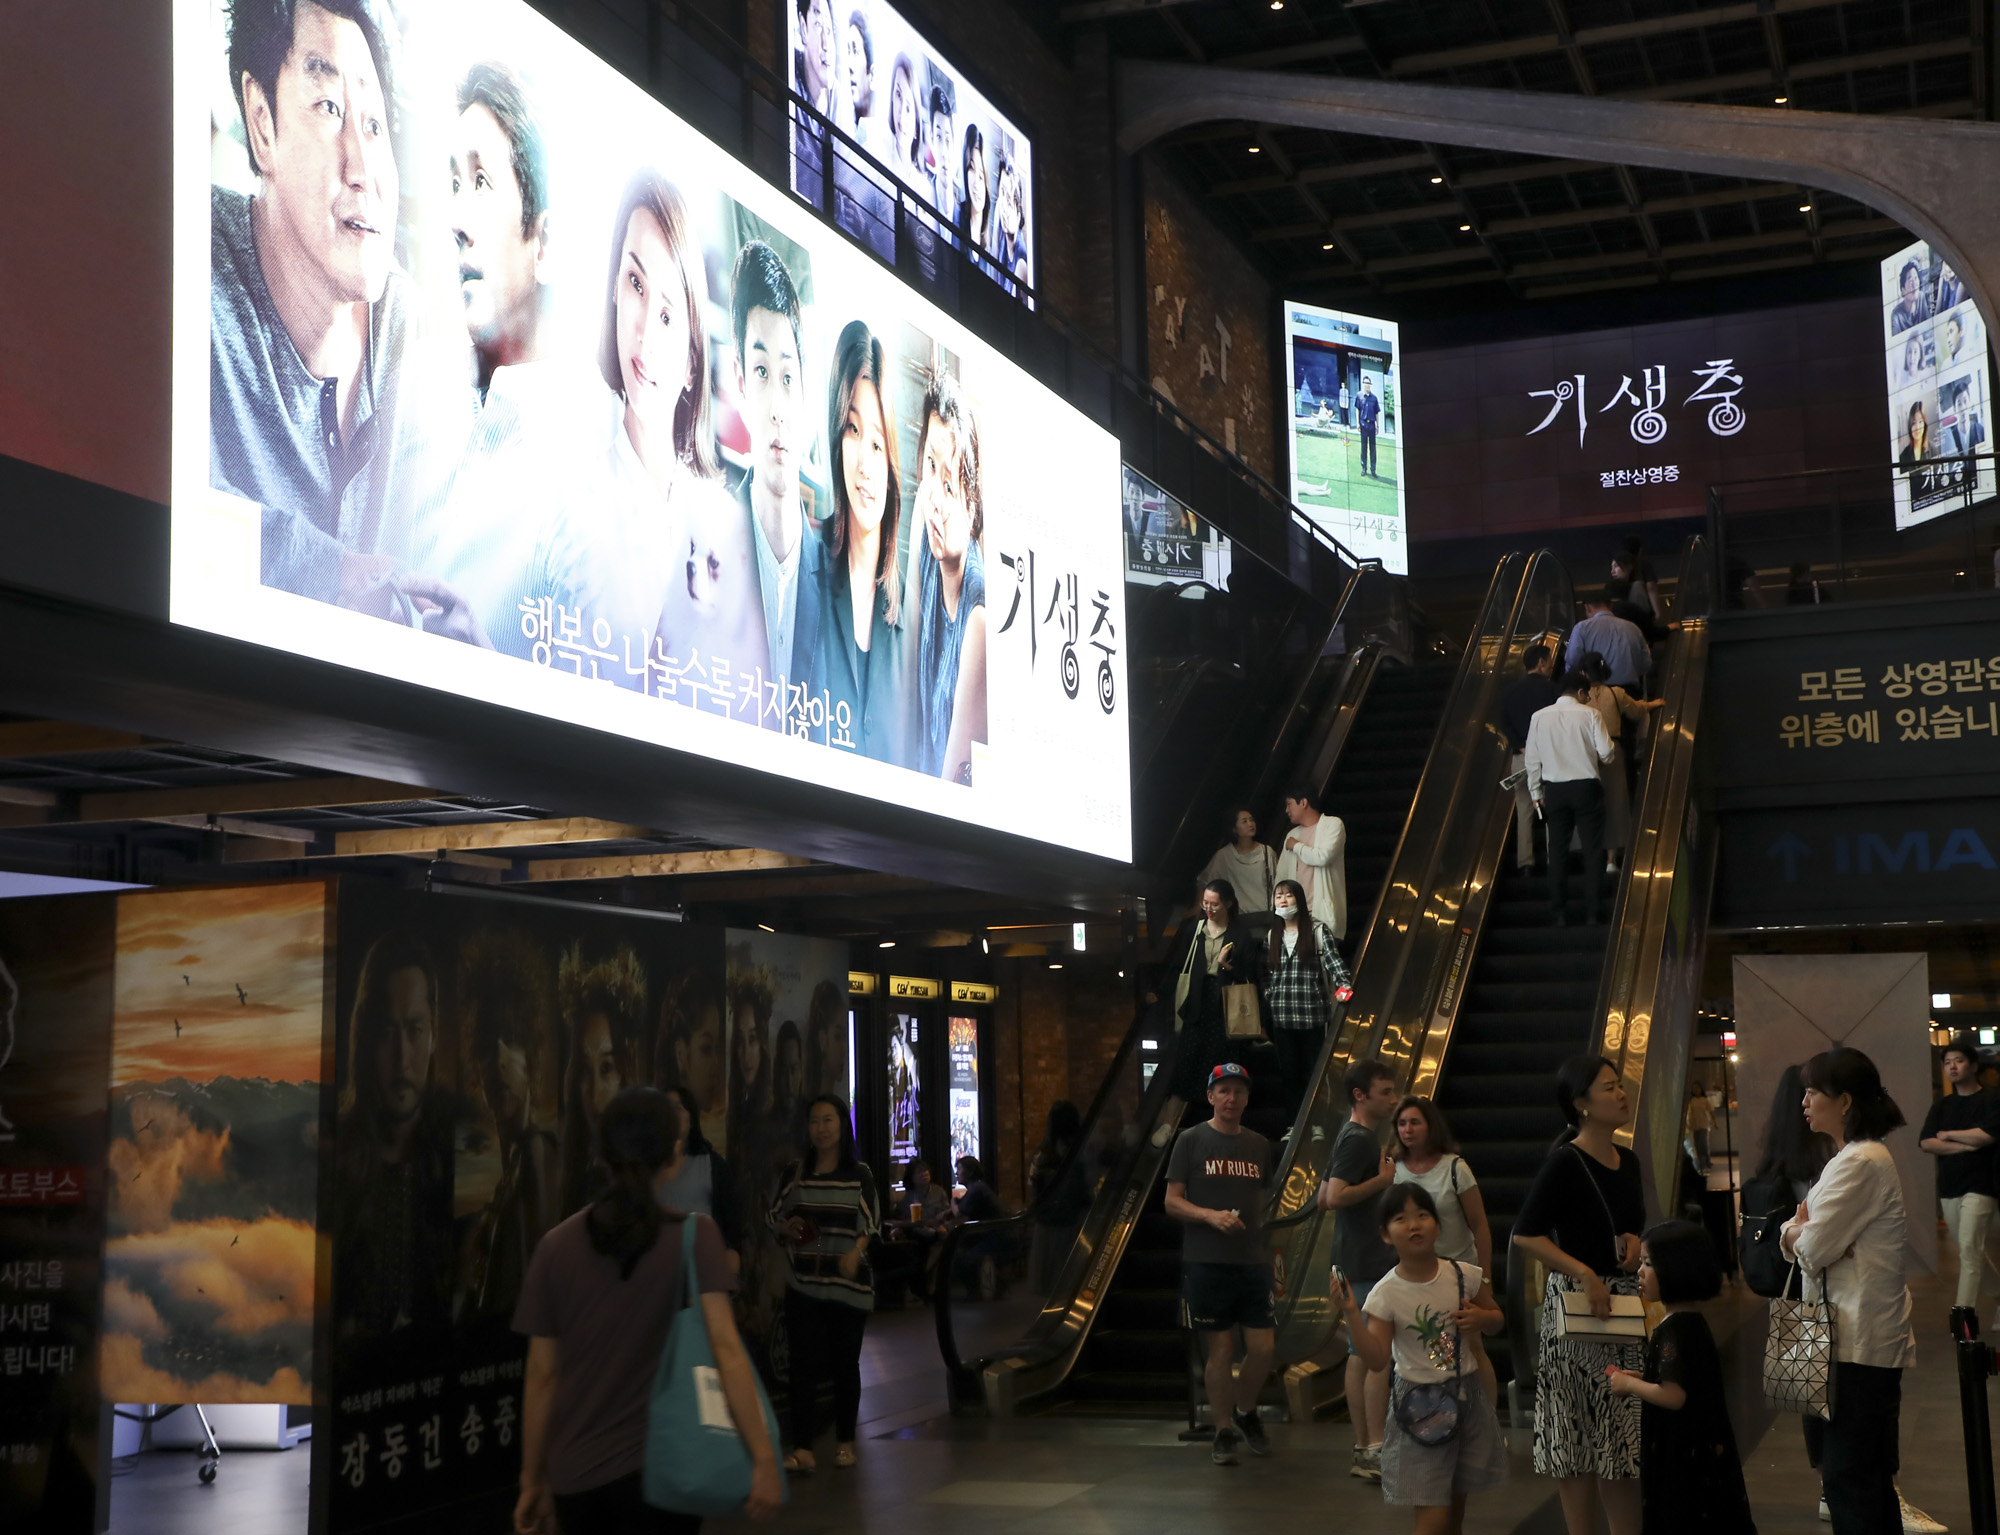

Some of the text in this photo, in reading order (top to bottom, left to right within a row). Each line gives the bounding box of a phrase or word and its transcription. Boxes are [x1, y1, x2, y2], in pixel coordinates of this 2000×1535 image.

[1526, 358, 1747, 450] 기생충
[1599, 465, 1681, 488] 절찬상영중
[1354, 515, 1398, 542] 기생충
[997, 547, 1118, 715] 기생충
[518, 596, 857, 749] 행복은 나눌수록 커지잖아요
[1798, 667, 1866, 701] 모든
[1779, 702, 1998, 748] 위층에 있습니
[1205, 1159, 1261, 1179] MY RULES
[0, 1259, 64, 1289] 사진을
[0, 1345, 74, 1376] 립니다!
[340, 1413, 443, 1489] 장동건
